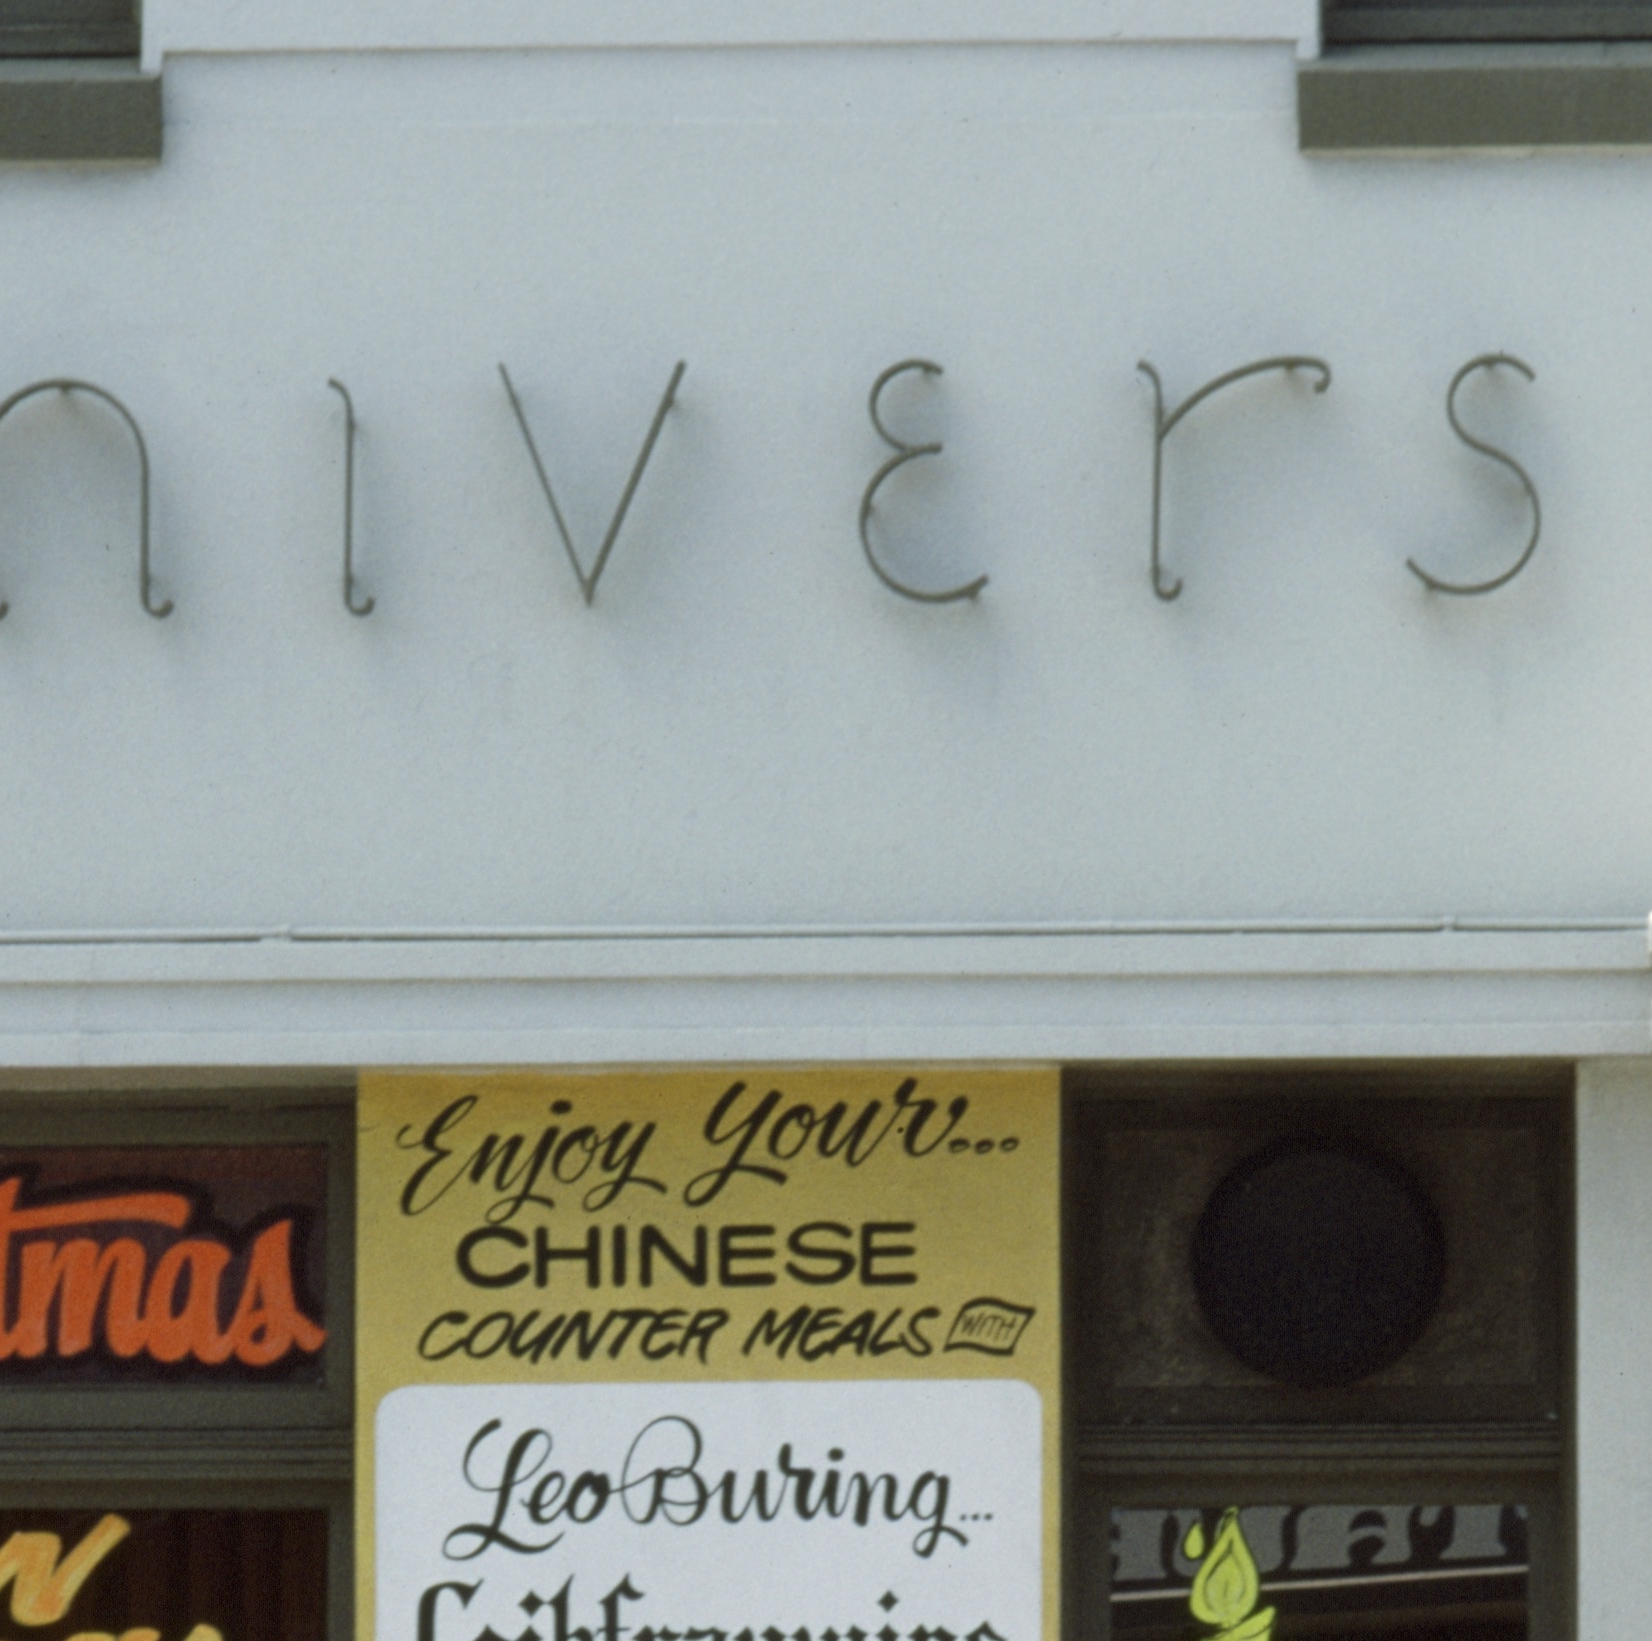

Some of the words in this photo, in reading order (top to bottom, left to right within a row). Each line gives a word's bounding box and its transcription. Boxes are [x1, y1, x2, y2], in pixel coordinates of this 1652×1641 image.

[397, 1094, 667, 1224] Enjoy
[454, 1220, 919, 1289] CHINESE
[417, 1306, 729, 1362] COUNTER
[743, 1306, 943, 1360] MEALS
[441, 1416, 621, 1560] Leo
